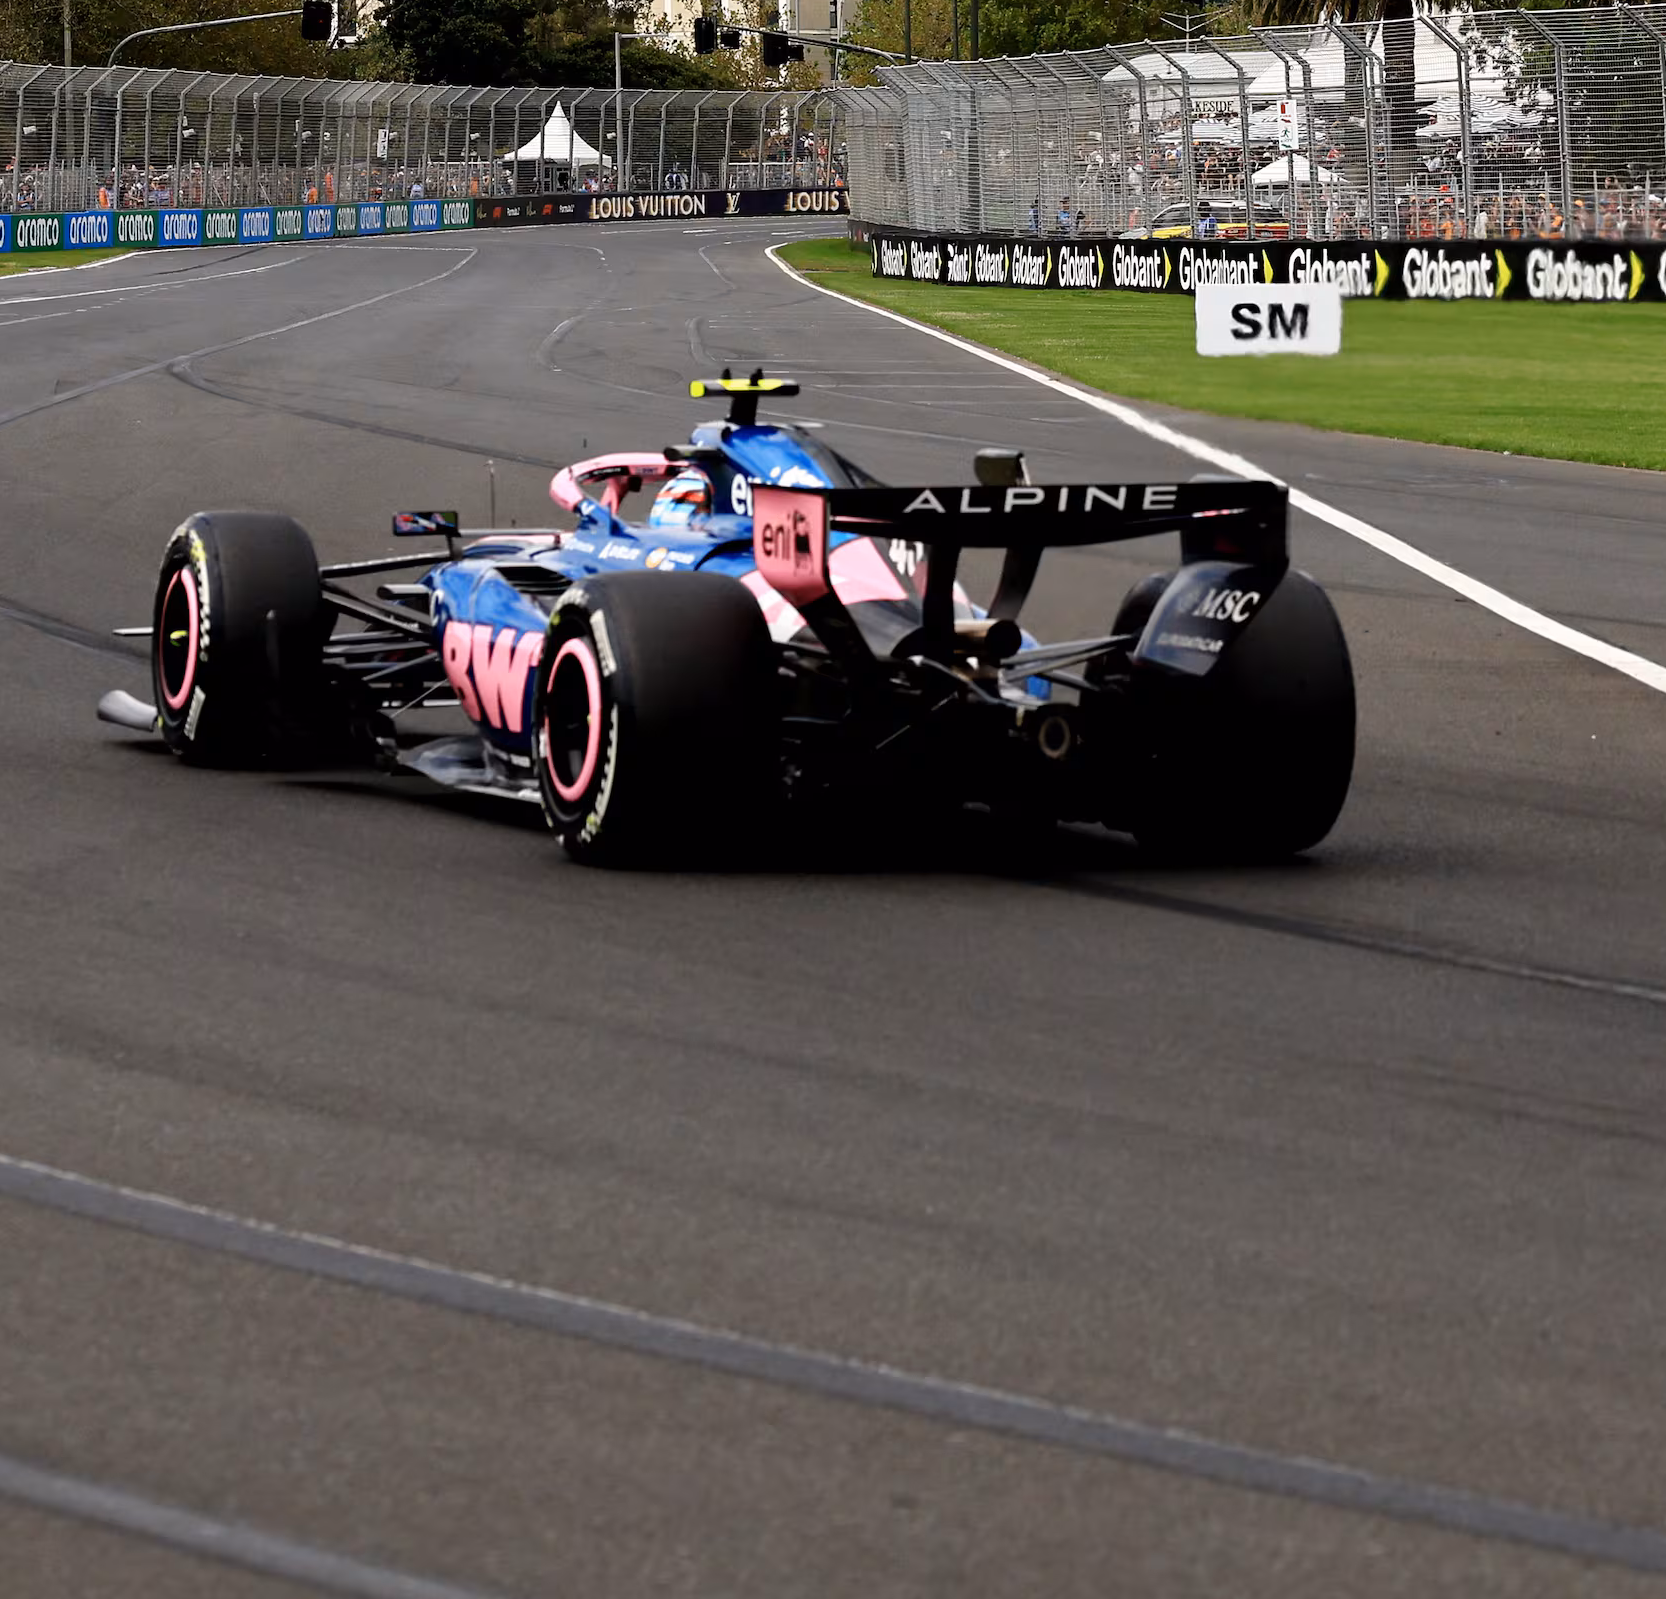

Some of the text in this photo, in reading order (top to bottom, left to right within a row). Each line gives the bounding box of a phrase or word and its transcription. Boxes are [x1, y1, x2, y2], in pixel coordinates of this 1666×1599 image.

[1193, 101, 1233, 112] KESIDE
[589, 195, 705, 220] LOUIS VUITTON
[786, 191, 839, 212] LOUIS
[17, 217, 60, 248] aramco
[70, 215, 108, 244] aramco
[118, 214, 154, 241] aramco
[1058, 246, 1098, 289] Globant
[1113, 245, 1162, 289] Globant
[1288, 248, 1372, 297] Globant
[1403, 248, 1494, 299] Globant
[1527, 239, 1627, 300] Globant
[1231, 303, 1309, 340] SM
[903, 486, 1178, 513] ALPINE
[762, 515, 791, 561] eni
[1192, 588, 1260, 623] MSC
